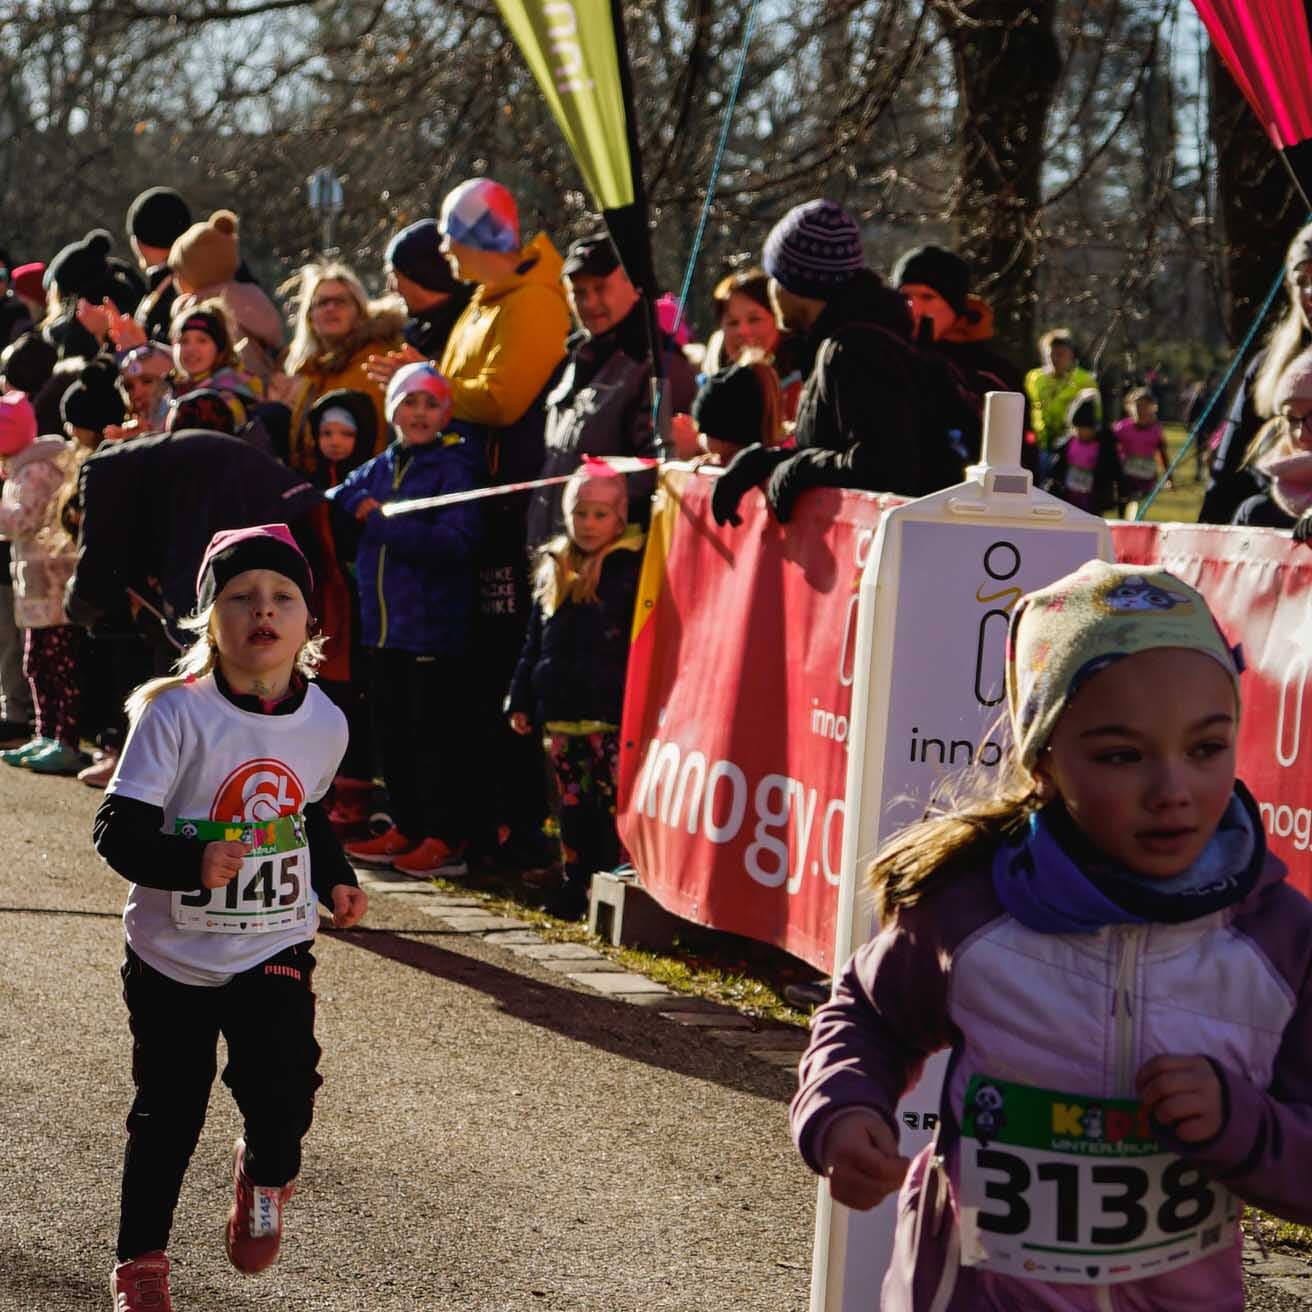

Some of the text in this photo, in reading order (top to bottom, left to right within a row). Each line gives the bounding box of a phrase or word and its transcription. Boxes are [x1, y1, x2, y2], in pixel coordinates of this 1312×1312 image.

[810, 698, 853, 753] inno
[909, 727, 1003, 767] inno
[635, 708, 847, 895] innogy.c
[976, 1148, 1216, 1246] 3138
